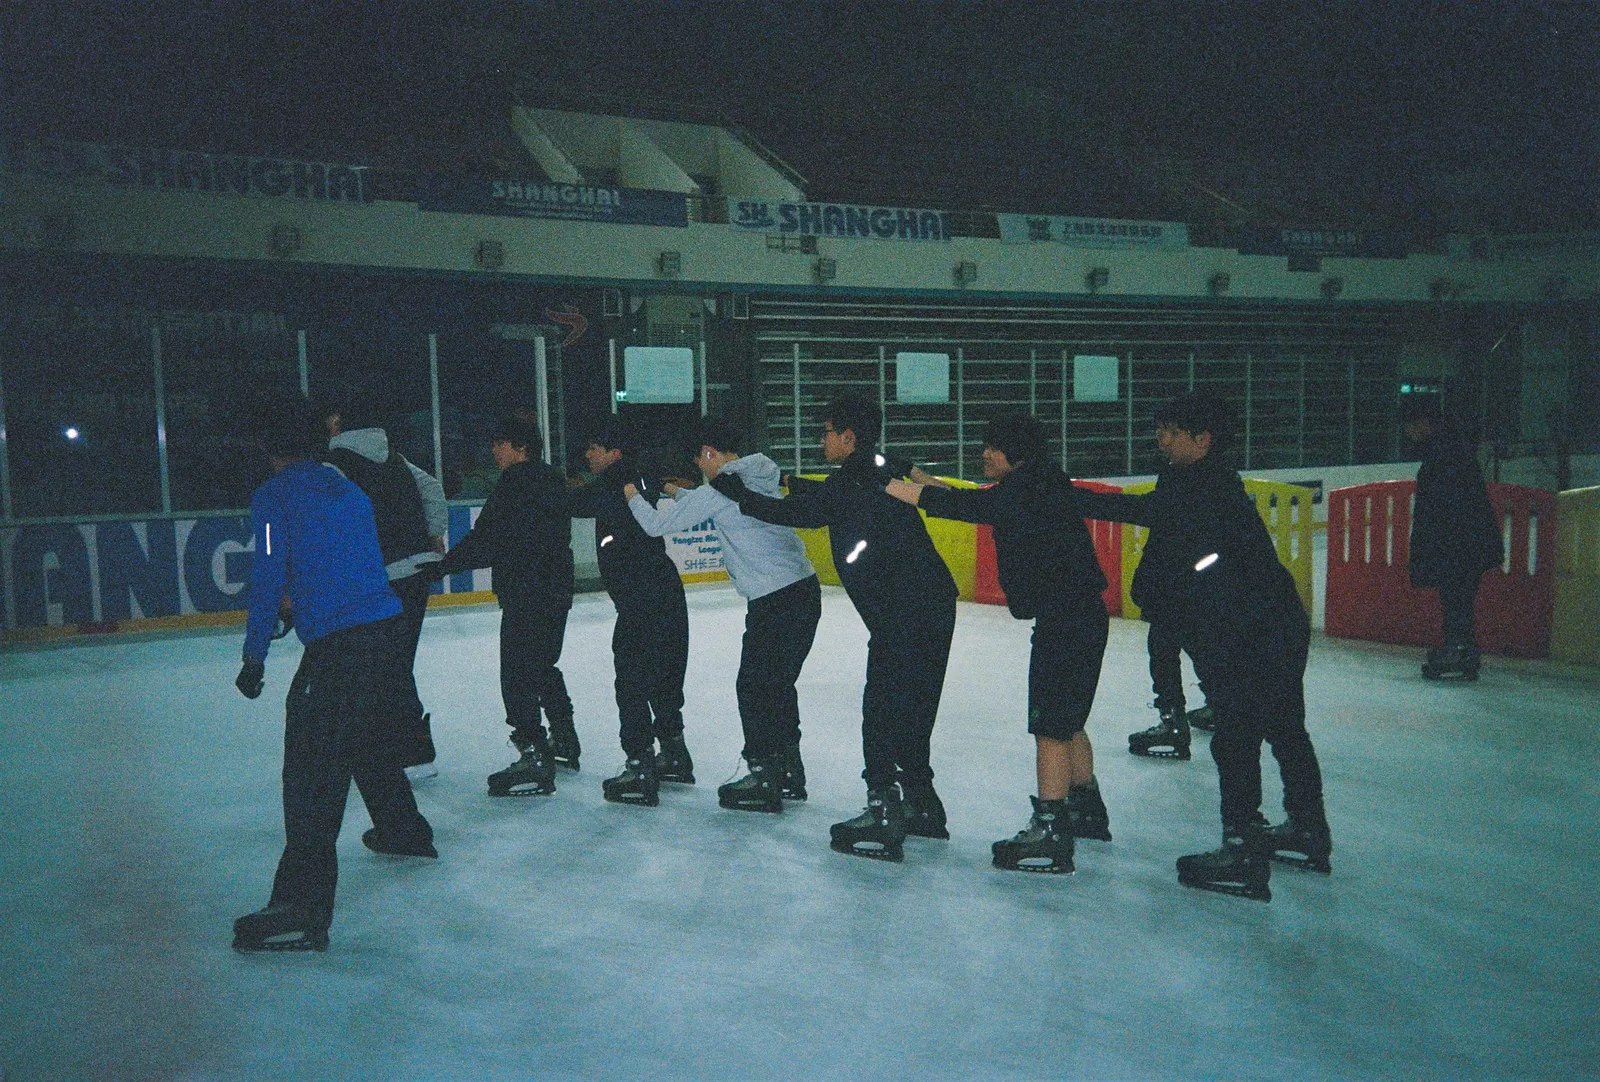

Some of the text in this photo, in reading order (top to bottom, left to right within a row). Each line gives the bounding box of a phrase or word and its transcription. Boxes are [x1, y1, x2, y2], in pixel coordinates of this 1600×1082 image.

[492, 180, 621, 207] SHANGHAI
[737, 201, 952, 241] SH SHANGHAI
[672, 536, 703, 546] Yangtze
